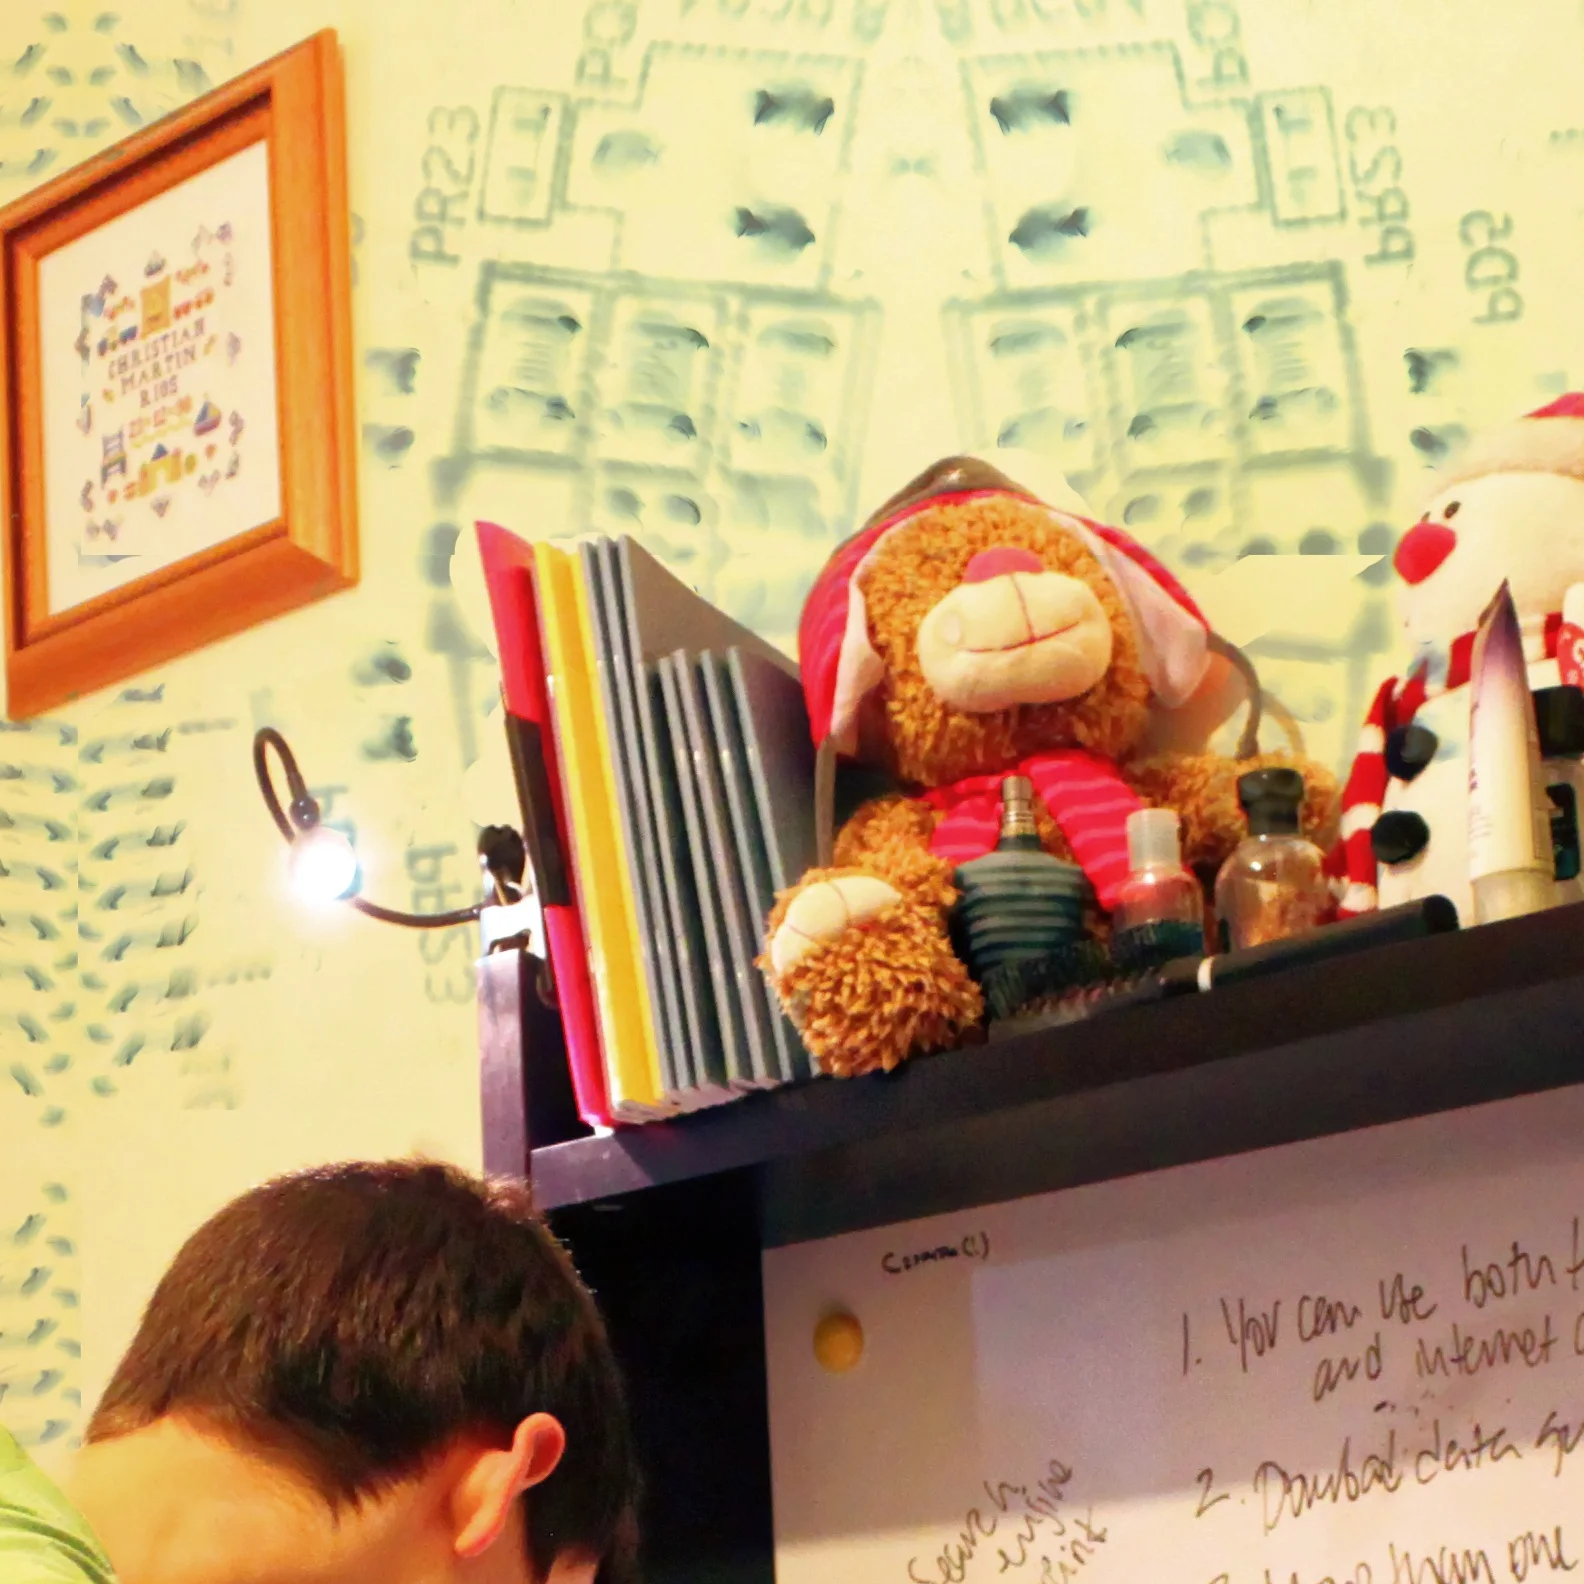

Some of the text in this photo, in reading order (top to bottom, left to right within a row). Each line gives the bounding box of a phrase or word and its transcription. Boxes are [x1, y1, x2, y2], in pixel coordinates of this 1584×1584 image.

[409, 104, 481, 267] PR23
[120, 344, 198, 396] MARTIN
[1297, 1294, 1362, 1343] can
[1461, 1240, 1557, 1309] both
[1314, 1331, 1384, 1402] and
